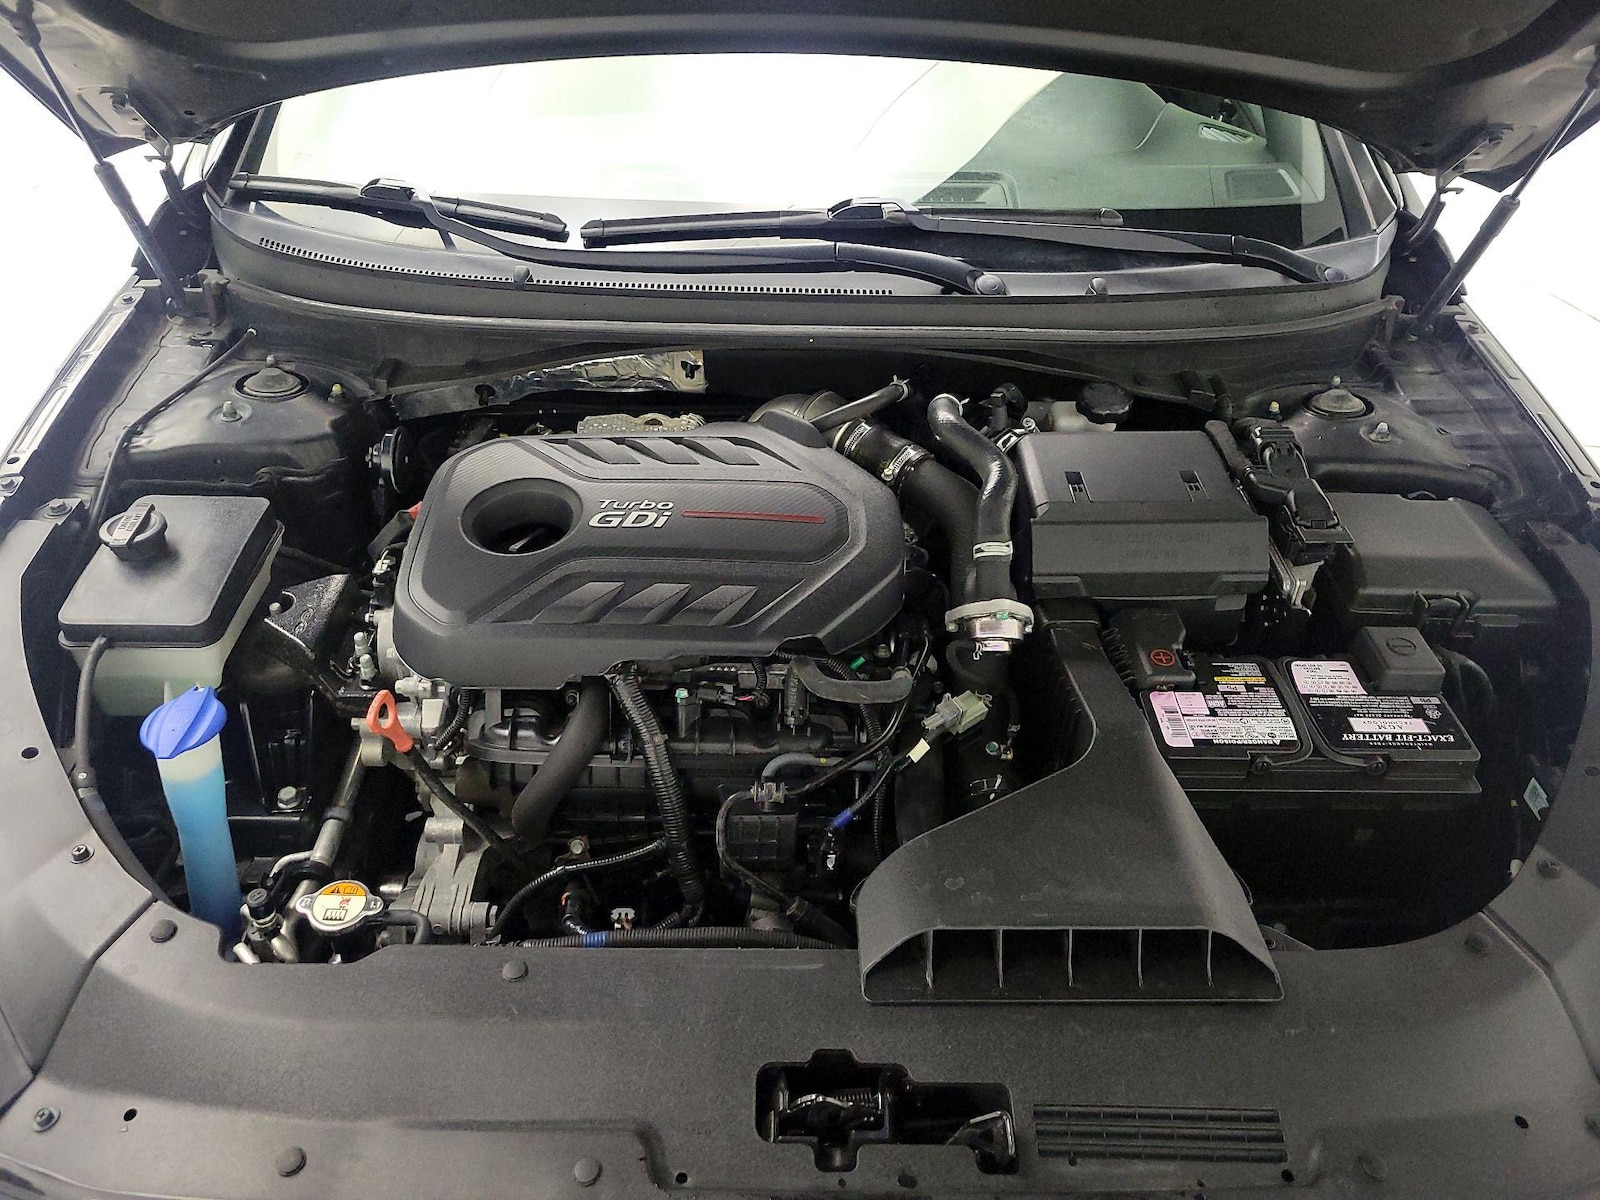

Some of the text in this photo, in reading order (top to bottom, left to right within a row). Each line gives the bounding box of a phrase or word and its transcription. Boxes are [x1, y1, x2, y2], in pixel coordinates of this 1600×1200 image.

[599, 499, 674, 510] Turbo
[588, 511, 672, 528] GDi
[1342, 733, 1455, 742] EXACT-FIT BATTERY
